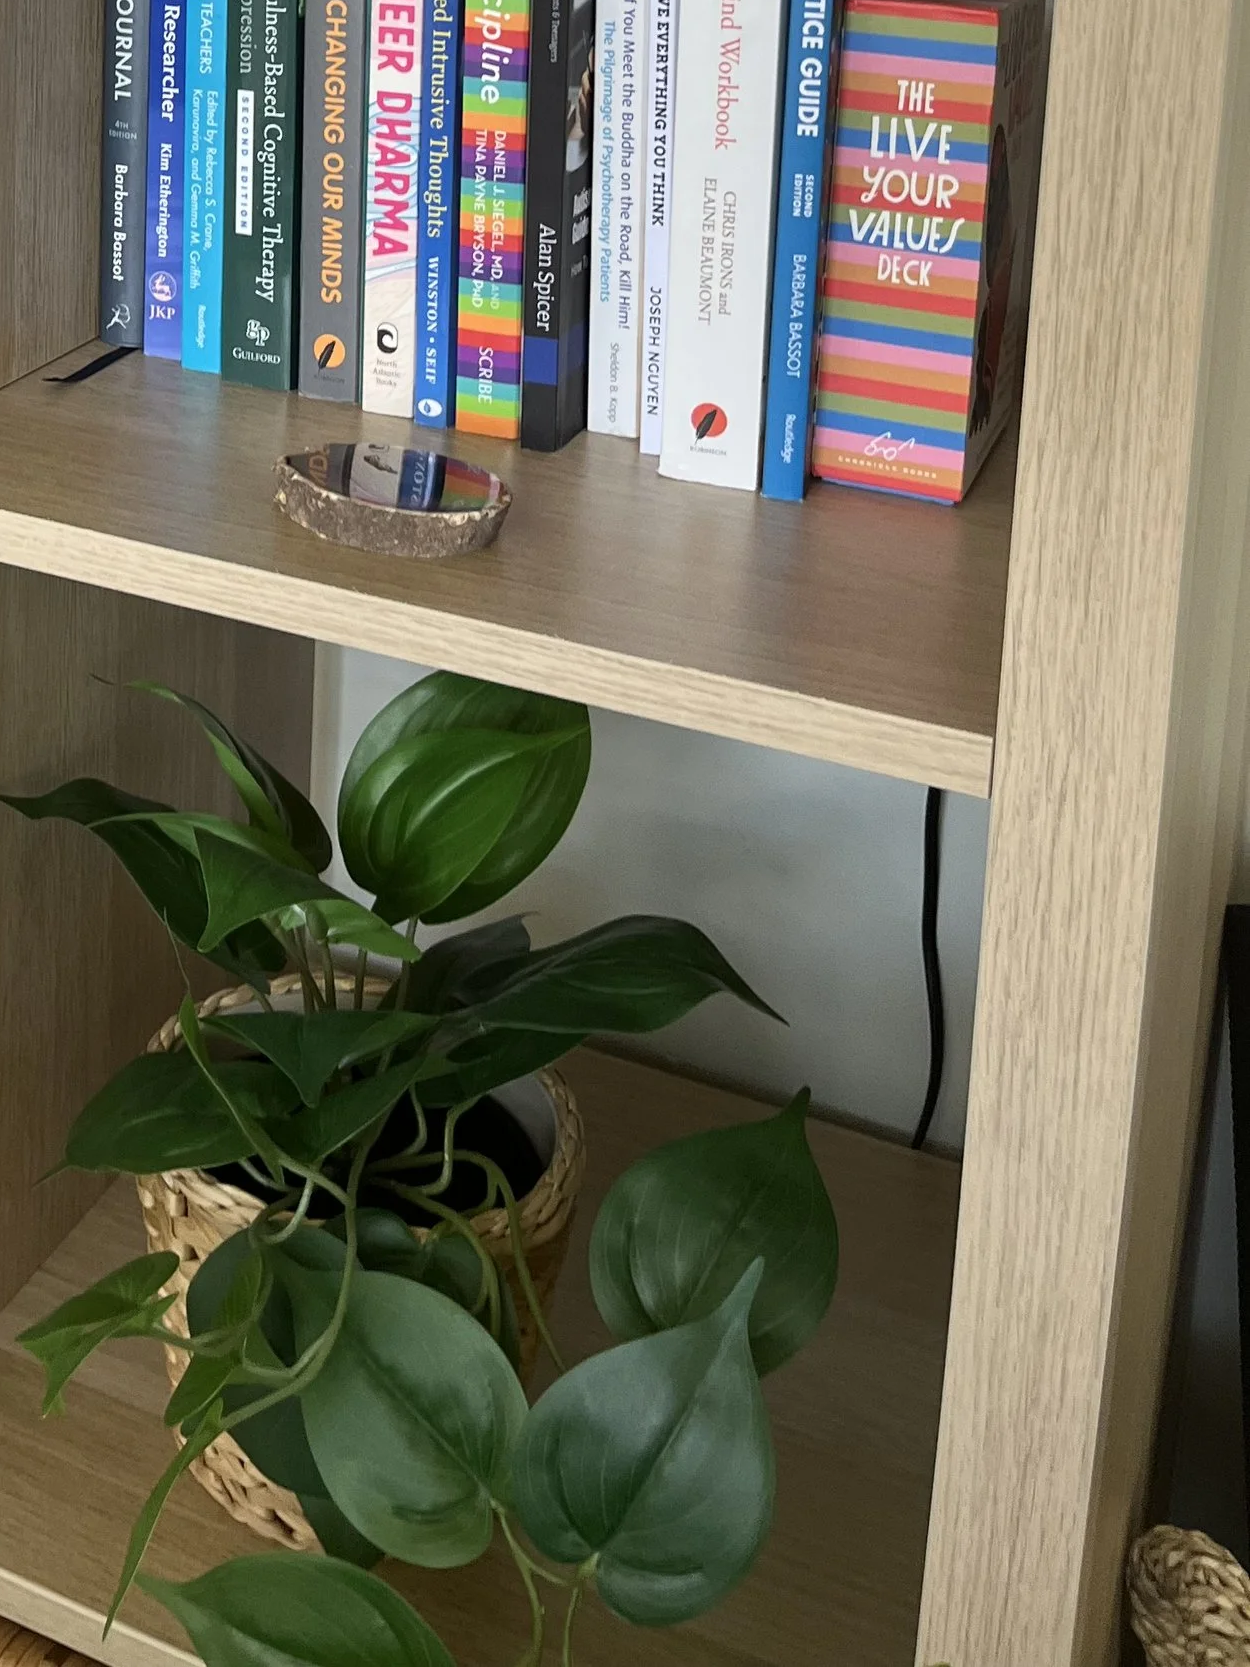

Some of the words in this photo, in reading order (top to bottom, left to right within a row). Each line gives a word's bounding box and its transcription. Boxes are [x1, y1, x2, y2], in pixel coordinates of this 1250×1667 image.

[199, 2, 214, 76] TEACHERS
[604, 21, 616, 46] The
[623, 4, 636, 35] You
[160, 4, 181, 123] Researcher
[429, 30, 452, 130] Intrusive
[600, 48, 616, 124] Pilgrimage
[621, 41, 636, 79] Meet
[654, 24, 670, 131] EVERYTHING
[206, 89, 219, 128] Edited
[621, 81, 636, 108] the
[714, 37, 742, 151] Workbook
[796, 57, 823, 138] GUIDE
[896, 79, 936, 115] THE
[205, 129, 217, 144] by
[241, 96, 250, 156] SECOND
[474, 128, 488, 169] TINA
[601, 126, 614, 138] of
[620, 113, 634, 172] Buddha
[652, 135, 667, 168] YOU
[870, 114, 953, 166] LIVE
[158, 142, 173, 171] Kim
[204, 145, 219, 195] Rebecca
[255, 123, 283, 219] Cognitive
[322, 152, 345, 211] OUR
[372, 90, 414, 257] DHARMA
[492, 129, 507, 182] DANIEL
[113, 163, 129, 229] Barbara
[204, 198, 217, 210] S.
[240, 166, 249, 230] EDITION
[423, 135, 450, 239] Thoughts
[473, 170, 488, 212] PAYNE
[492, 186, 506, 197] J.
[597, 139, 614, 246] Psychotherapy
[619, 194, 634, 221] the
[620, 174, 631, 191] on
[651, 172, 667, 227] THINK
[702, 177, 718, 233] ELAINE
[859, 164, 961, 210] YOUR
[156, 173, 173, 259] Etherington
[202, 213, 217, 252] Crane,
[490, 199, 506, 254] SIEGEL,
[721, 190, 737, 239] CHRIS
[848, 208, 966, 255] VALUES
[111, 230, 128, 282] Bassot
[255, 223, 283, 303] Therapy
[320, 217, 343, 304] MINDS
[472, 214, 487, 277] BRYSON,
[490, 255, 504, 282] MD,
[538, 222, 558, 269] Alan
[617, 223, 633, 265] Road,
[719, 239, 735, 290] IRONS
[425, 256, 440, 333] WINSTON
[599, 247, 612, 303] Patients
[617, 269, 632, 293] Kill
[697, 235, 716, 327] BEAUMONT
[790, 253, 807, 320] BARBARA
[876, 253, 934, 288] DECK
[149, 304, 176, 320] JKP
[532, 272, 556, 332] Spicer
[617, 294, 632, 330] Him!
[648, 286, 662, 347] JOSEPH
[717, 292, 731, 317] and
[232, 347, 281, 365] GUILFORD
[425, 346, 438, 385] SEIF
[478, 346, 494, 405] SCRIBE
[786, 322, 803, 379] BASSOT
[646, 351, 661, 417] NGUYEN
[780, 412, 798, 464] Routledge
[837, 455, 900, 473] CHRONICLE
[902, 466, 938, 480] BOOKS
